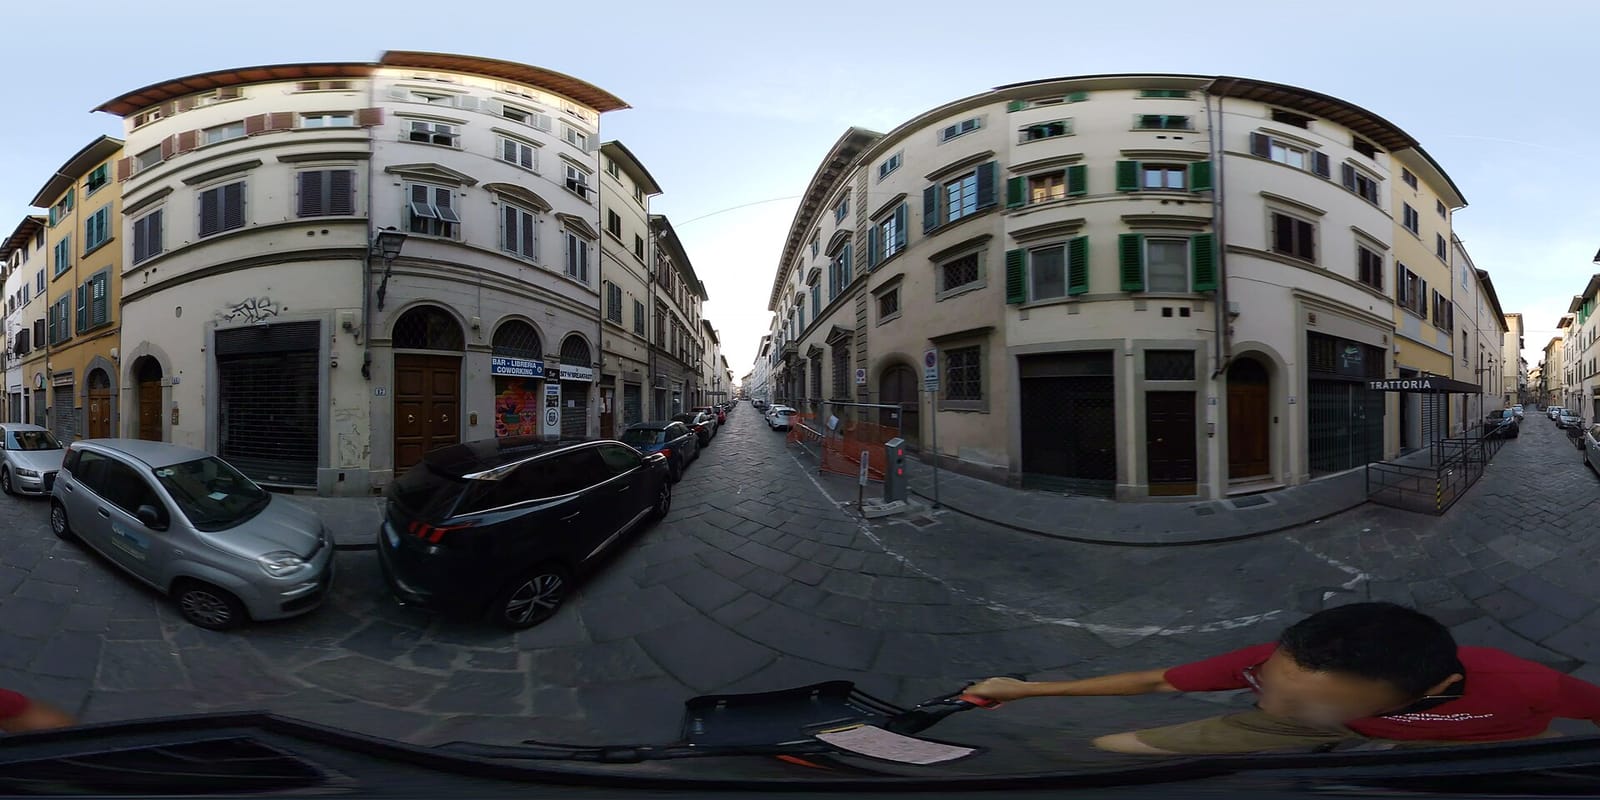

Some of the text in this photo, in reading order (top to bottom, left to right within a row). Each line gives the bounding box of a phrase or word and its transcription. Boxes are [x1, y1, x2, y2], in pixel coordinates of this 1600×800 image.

[492, 358, 506, 366] BAR
[511, 360, 536, 368] LIBRERIA
[497, 366, 533, 375] COWORKING
[1370, 380, 1431, 389] TRATTORIA
